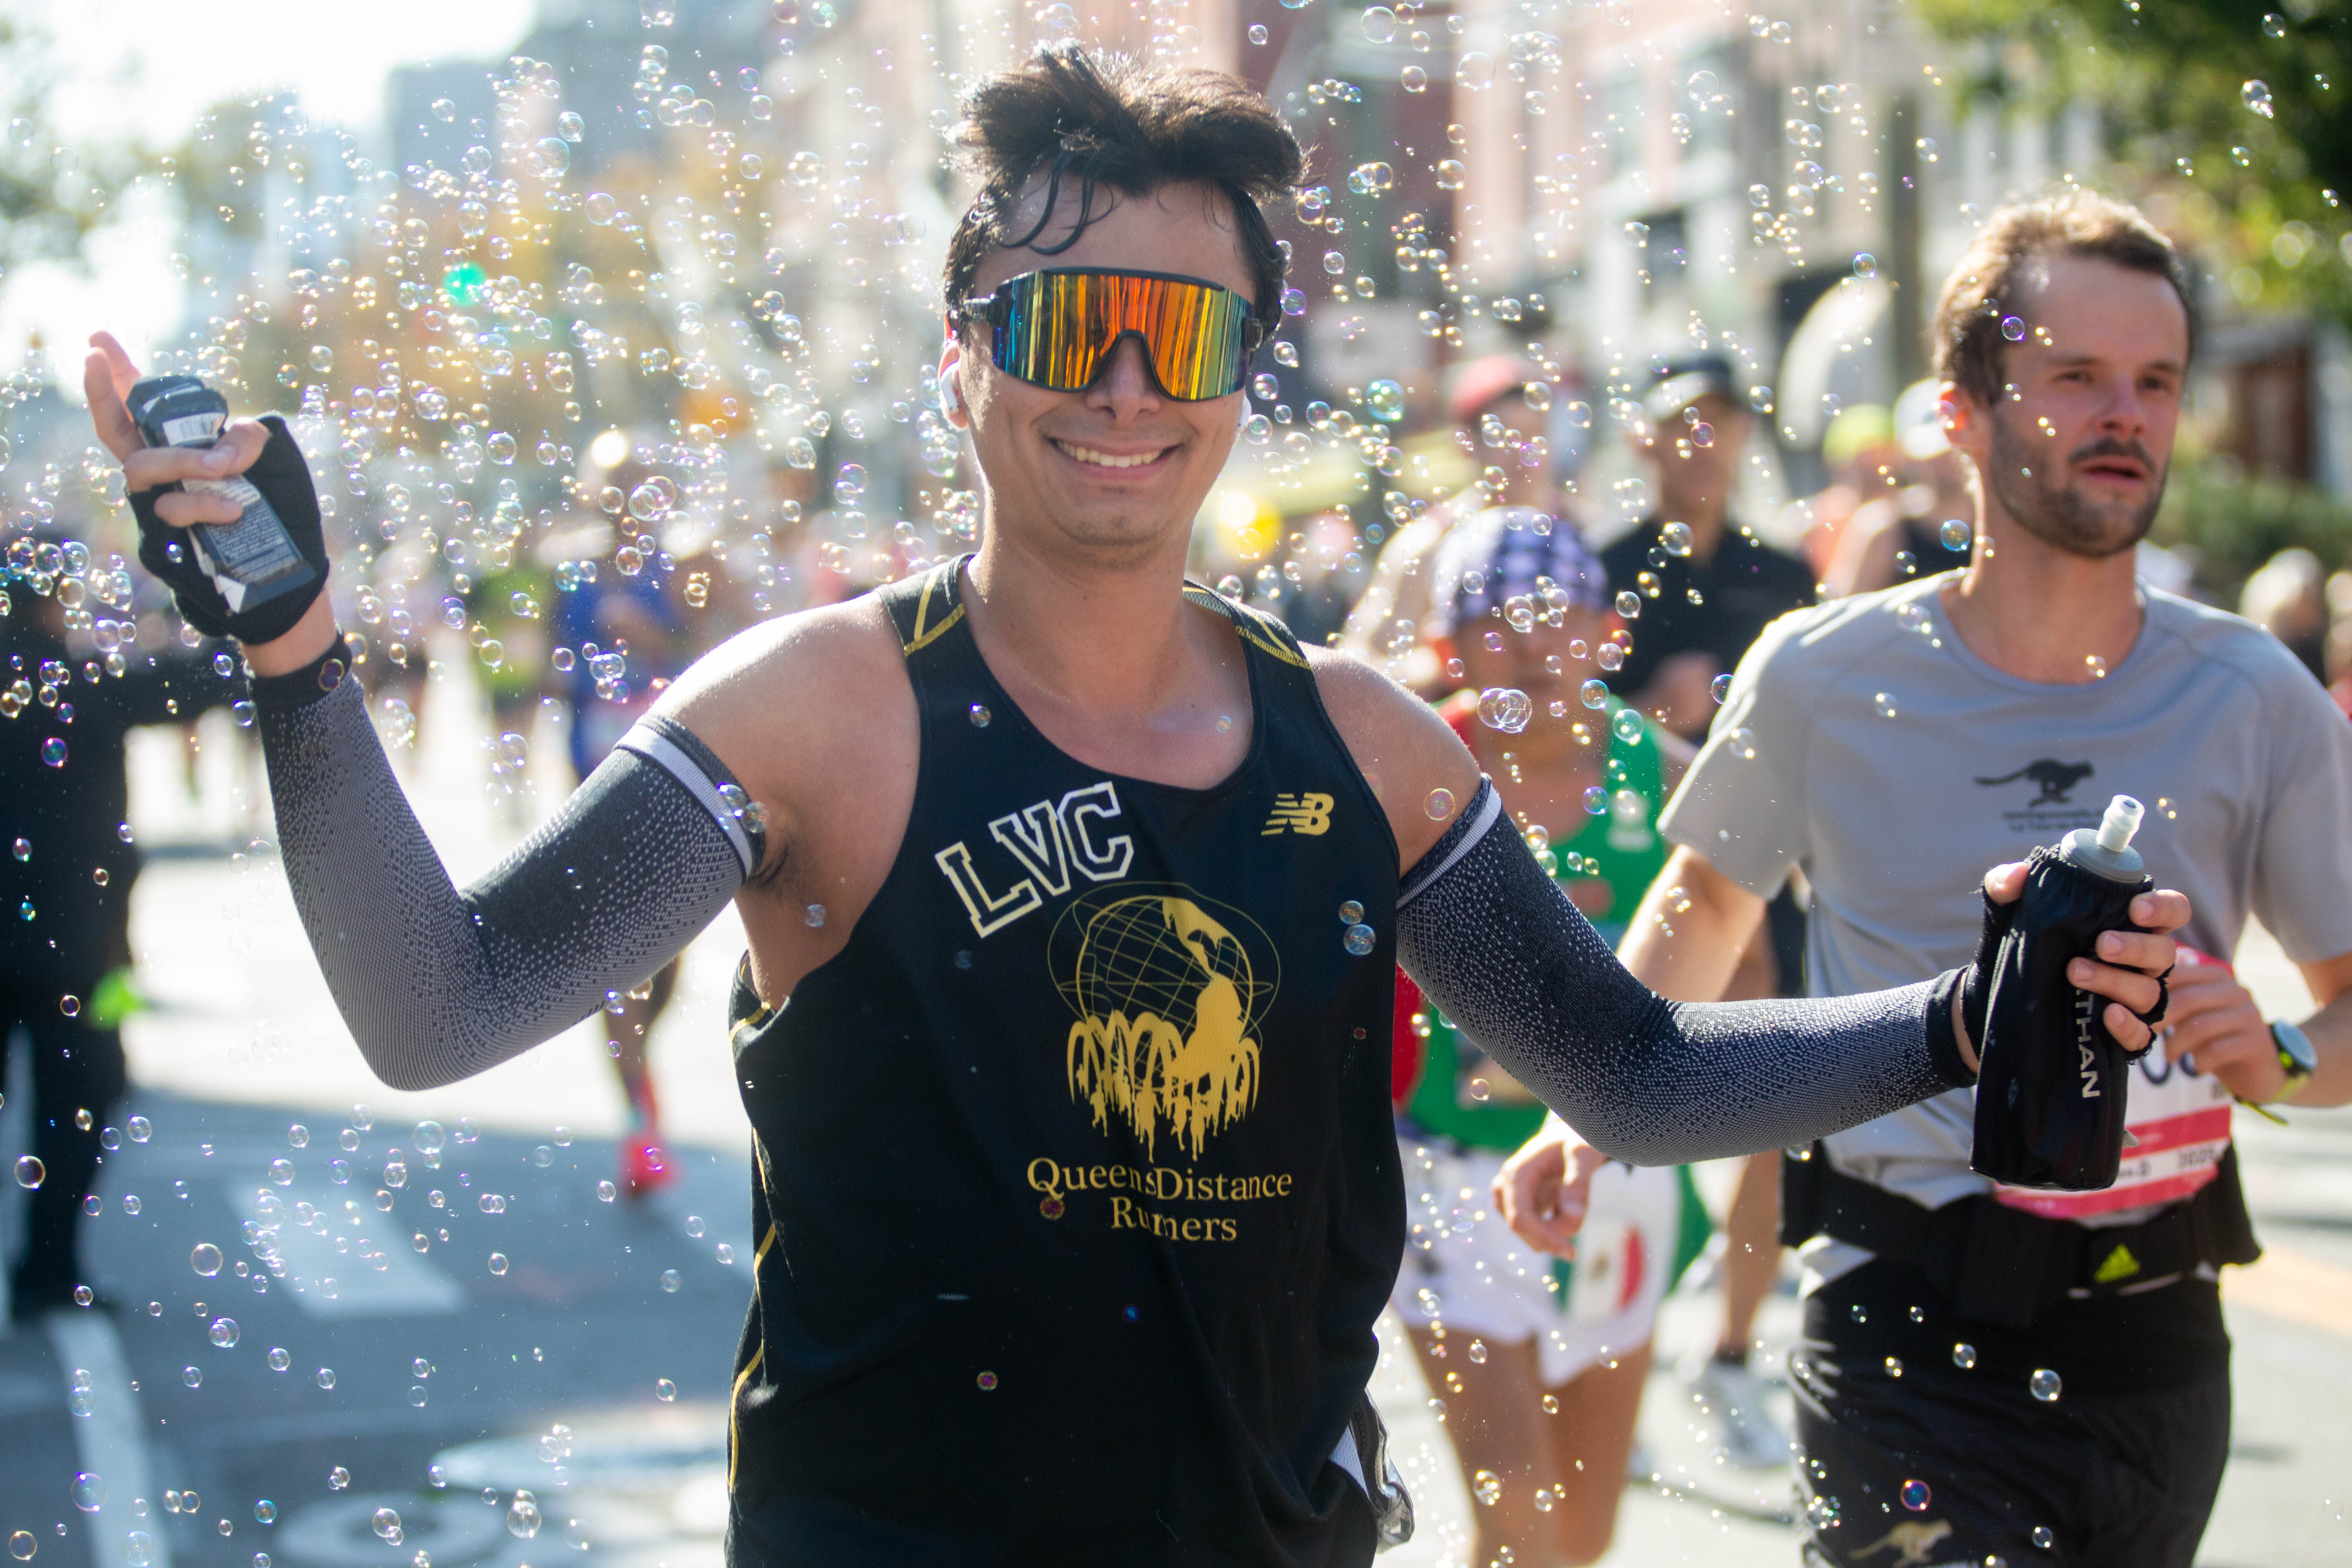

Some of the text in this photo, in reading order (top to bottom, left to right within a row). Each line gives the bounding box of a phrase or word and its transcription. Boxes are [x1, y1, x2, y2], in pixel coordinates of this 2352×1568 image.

[935, 781, 1134, 939] LVC
[2075, 990, 2100, 1098] THAN
[1027, 1157, 1292, 1200] Queens Distance
